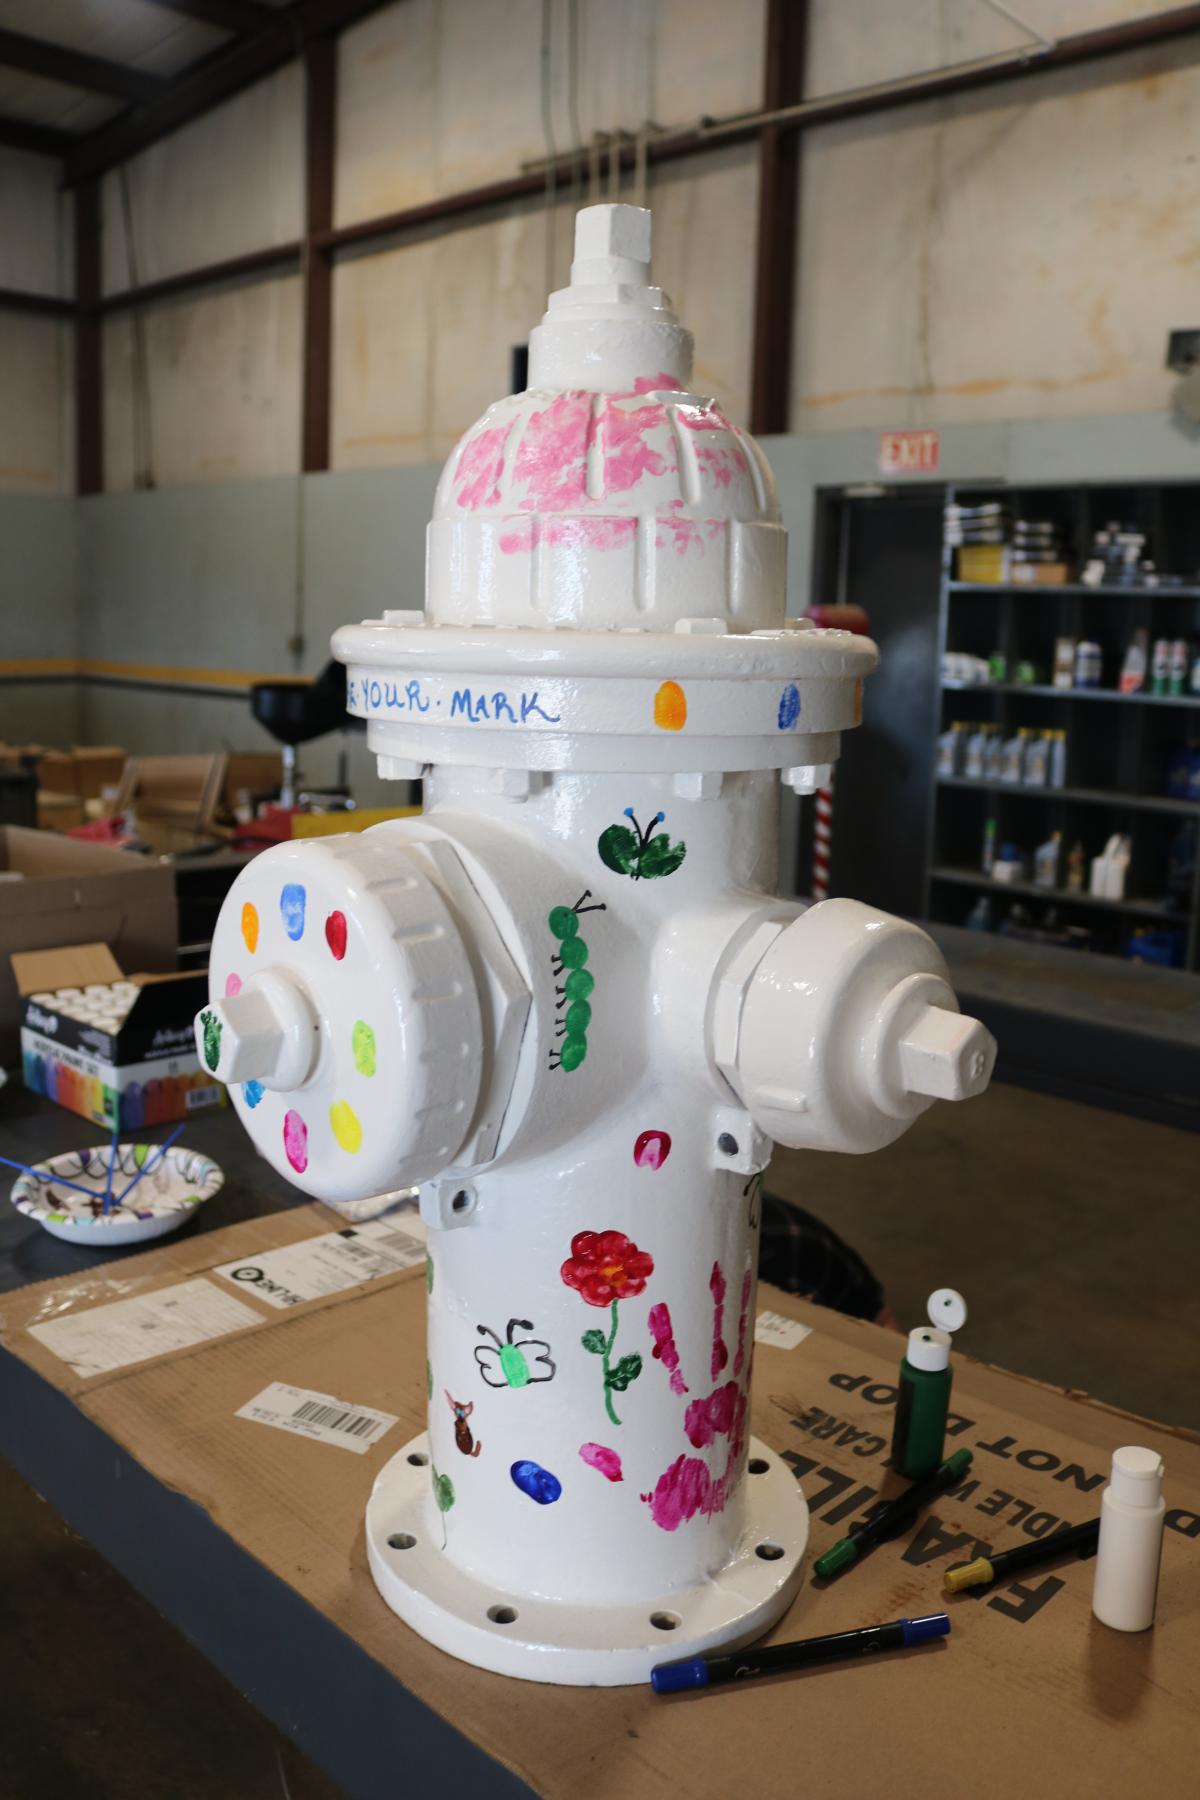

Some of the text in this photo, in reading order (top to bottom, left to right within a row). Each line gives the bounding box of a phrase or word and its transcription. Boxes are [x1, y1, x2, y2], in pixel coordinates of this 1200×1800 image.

[884, 433, 937, 466] EXIT
[450, 689, 561, 723] MARK
[789, 1406, 887, 1457] CARE
[974, 1436, 1107, 1493] NOT
